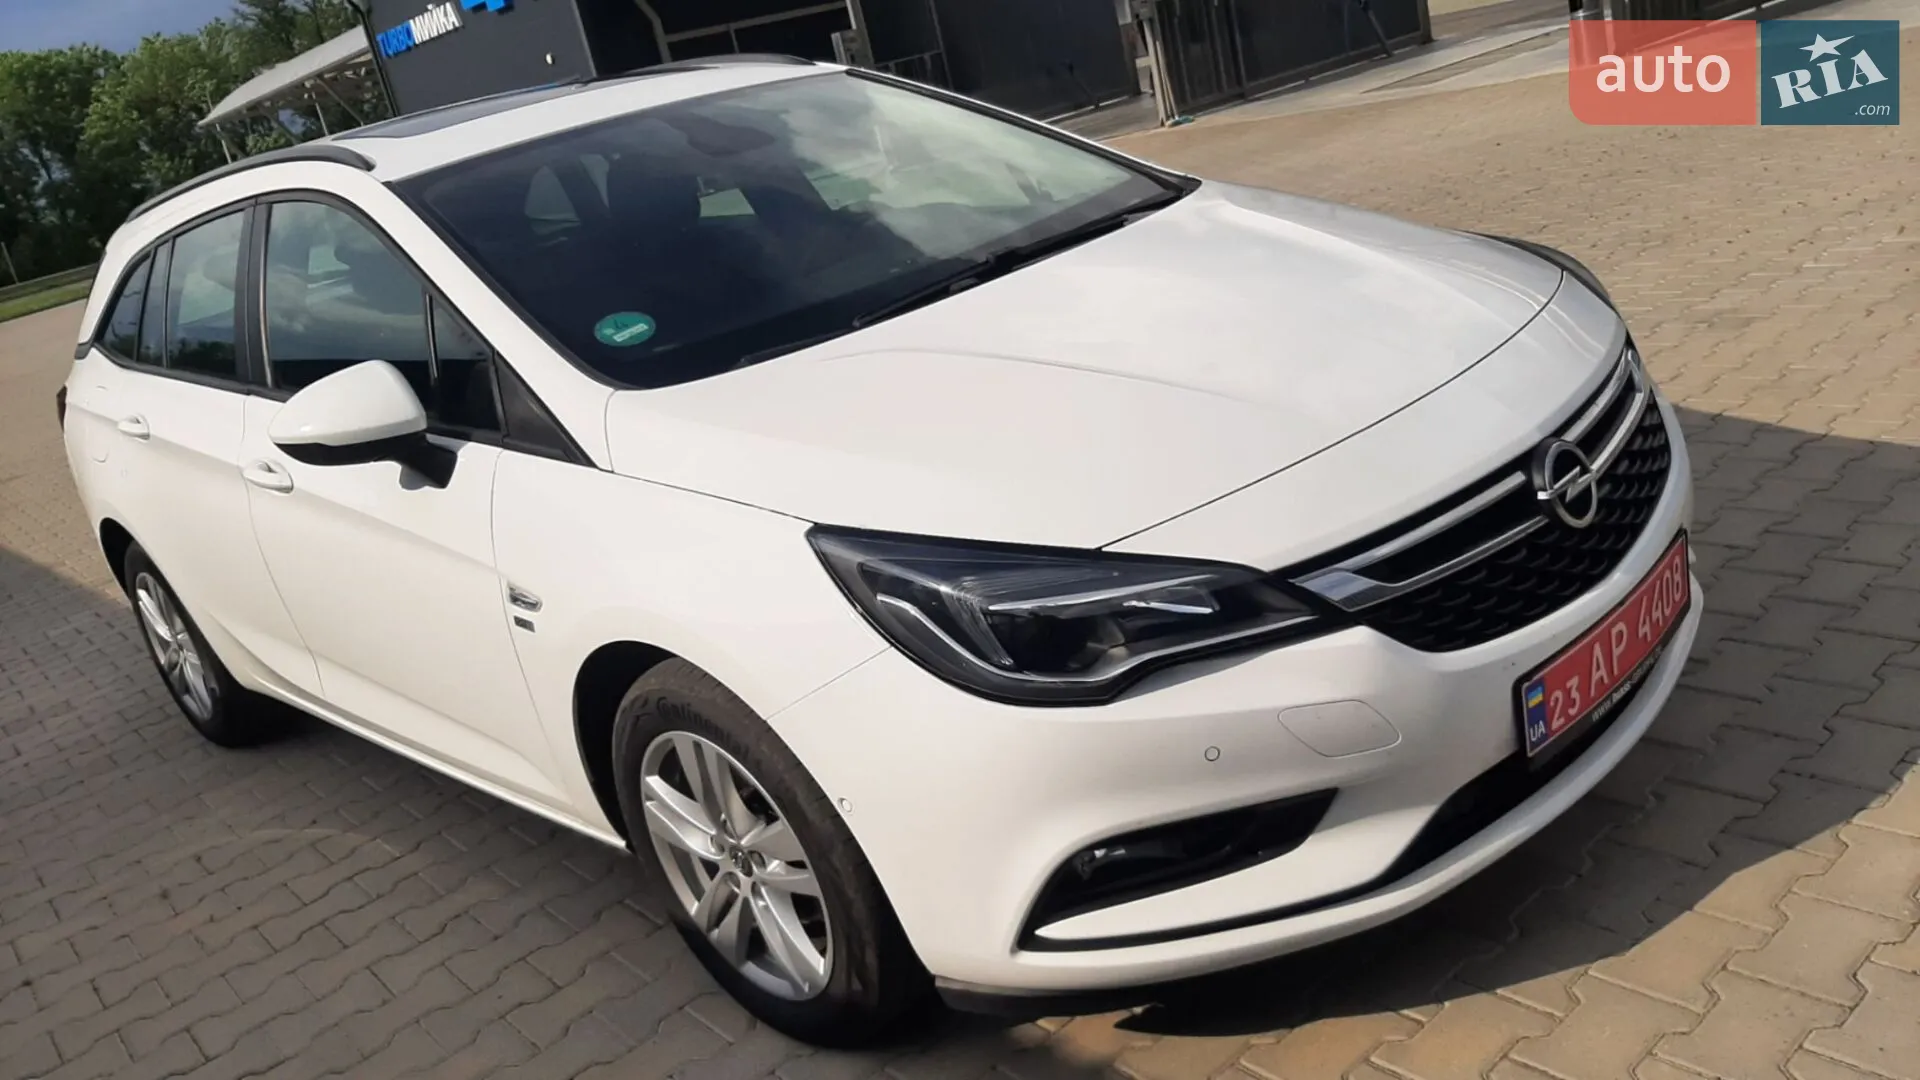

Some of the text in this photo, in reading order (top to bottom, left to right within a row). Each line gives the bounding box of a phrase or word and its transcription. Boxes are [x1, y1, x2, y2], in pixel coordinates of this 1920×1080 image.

[1550, 675, 1581, 731] 23
[1590, 621, 1628, 697] AP
[1638, 554, 1683, 642] 4408
[1530, 720, 1547, 742] UA
